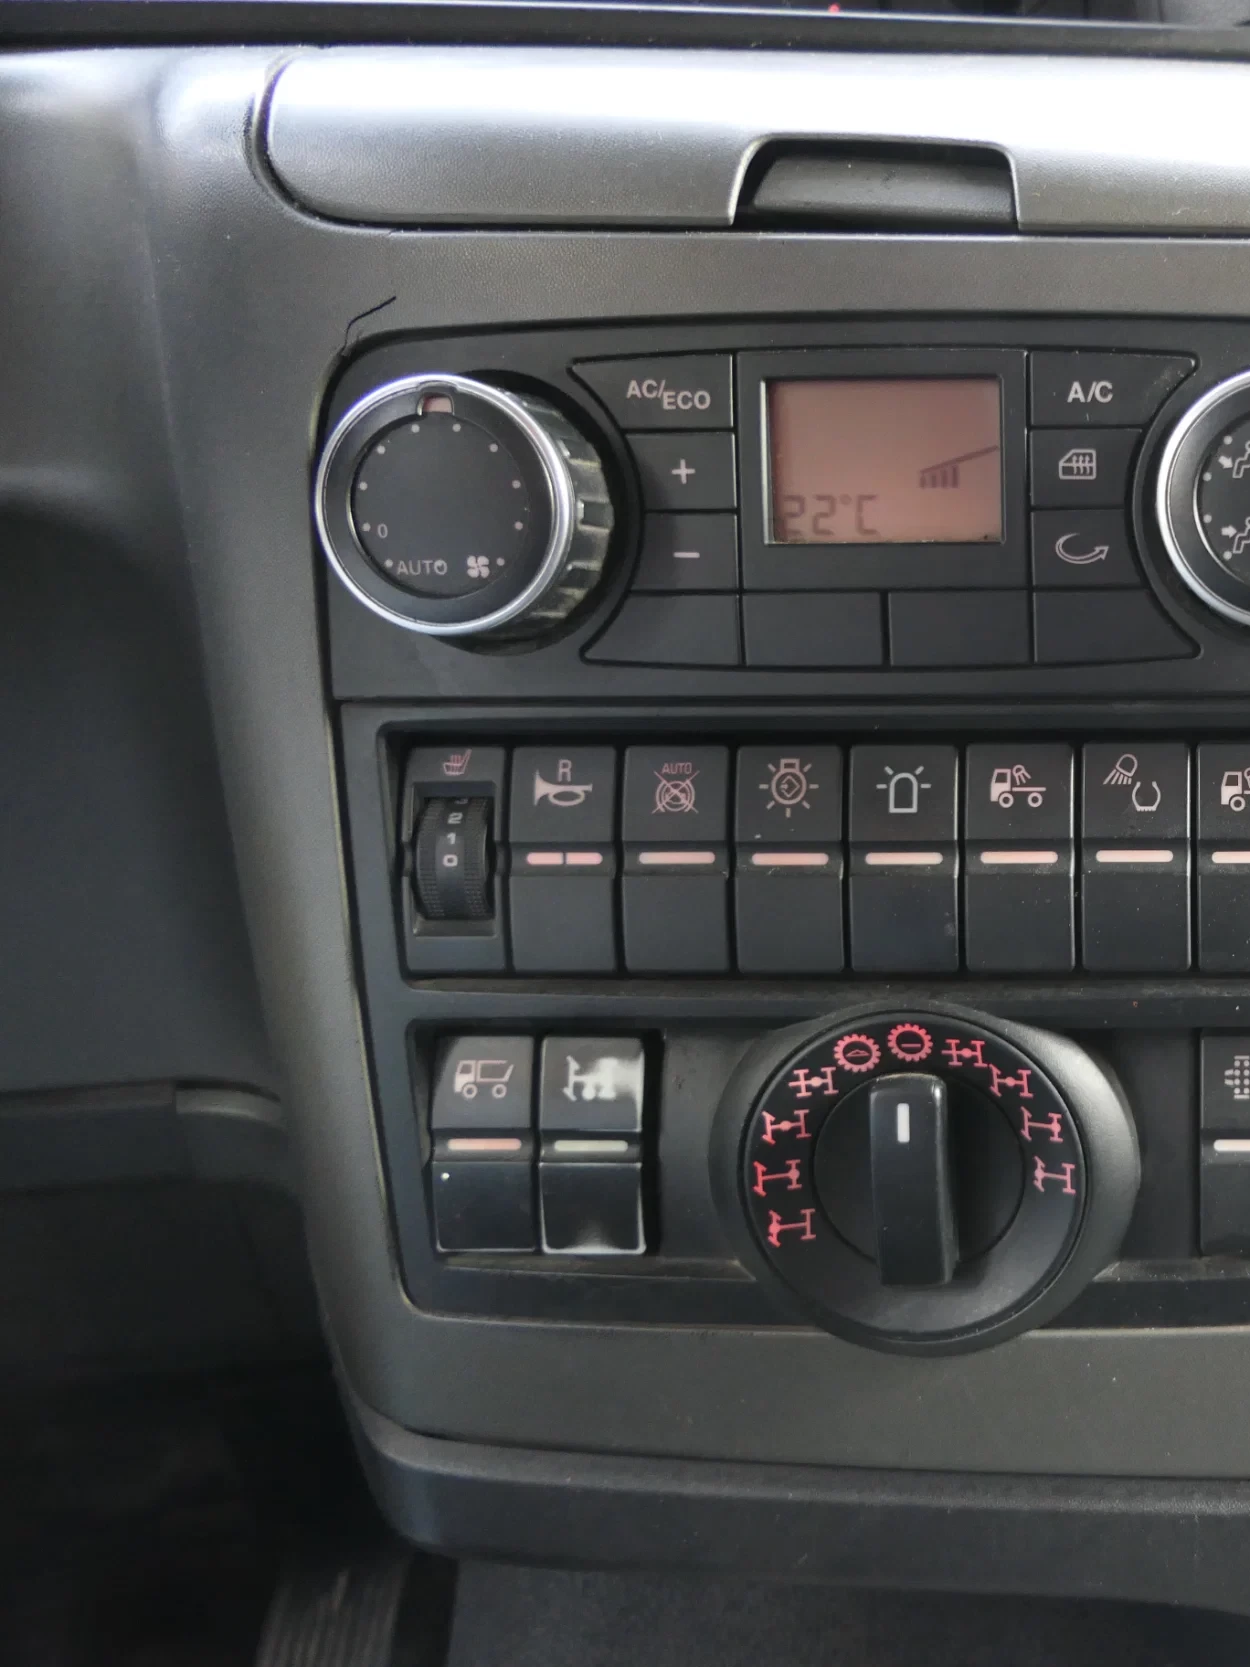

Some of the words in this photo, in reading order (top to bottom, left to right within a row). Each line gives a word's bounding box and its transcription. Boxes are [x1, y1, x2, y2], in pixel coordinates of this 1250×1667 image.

[1067, 380, 1113, 403] A/C
[396, 560, 448, 576] AUTO
[558, 759, 572, 782] R
[662, 761, 693, 775] AUTO
[447, 812, 463, 824] 2
[446, 831, 457, 845] 1
[442, 854, 458, 867] 0
